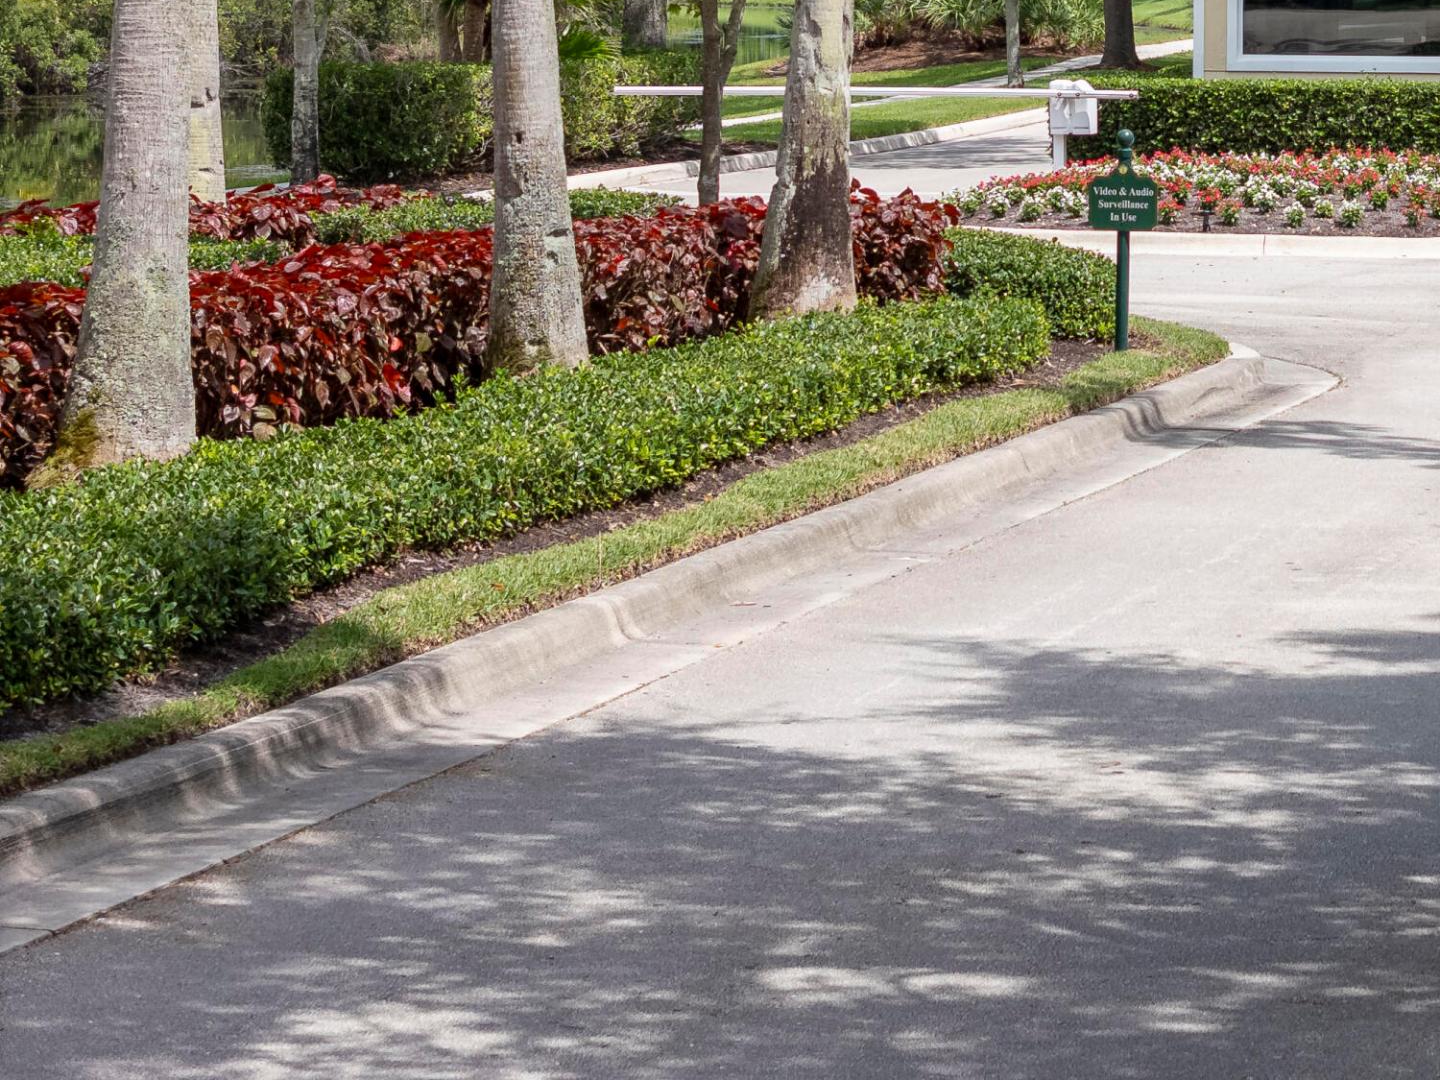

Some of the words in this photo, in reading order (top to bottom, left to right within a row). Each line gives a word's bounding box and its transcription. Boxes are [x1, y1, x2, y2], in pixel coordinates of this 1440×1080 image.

[1093, 186, 1117, 196] Video
[1118, 186, 1127, 196] &
[1129, 187, 1154, 197] Audio
[1098, 200, 1149, 209] Surveillance
[1110, 212, 1120, 222] In
[1121, 212, 1137, 222] Use
